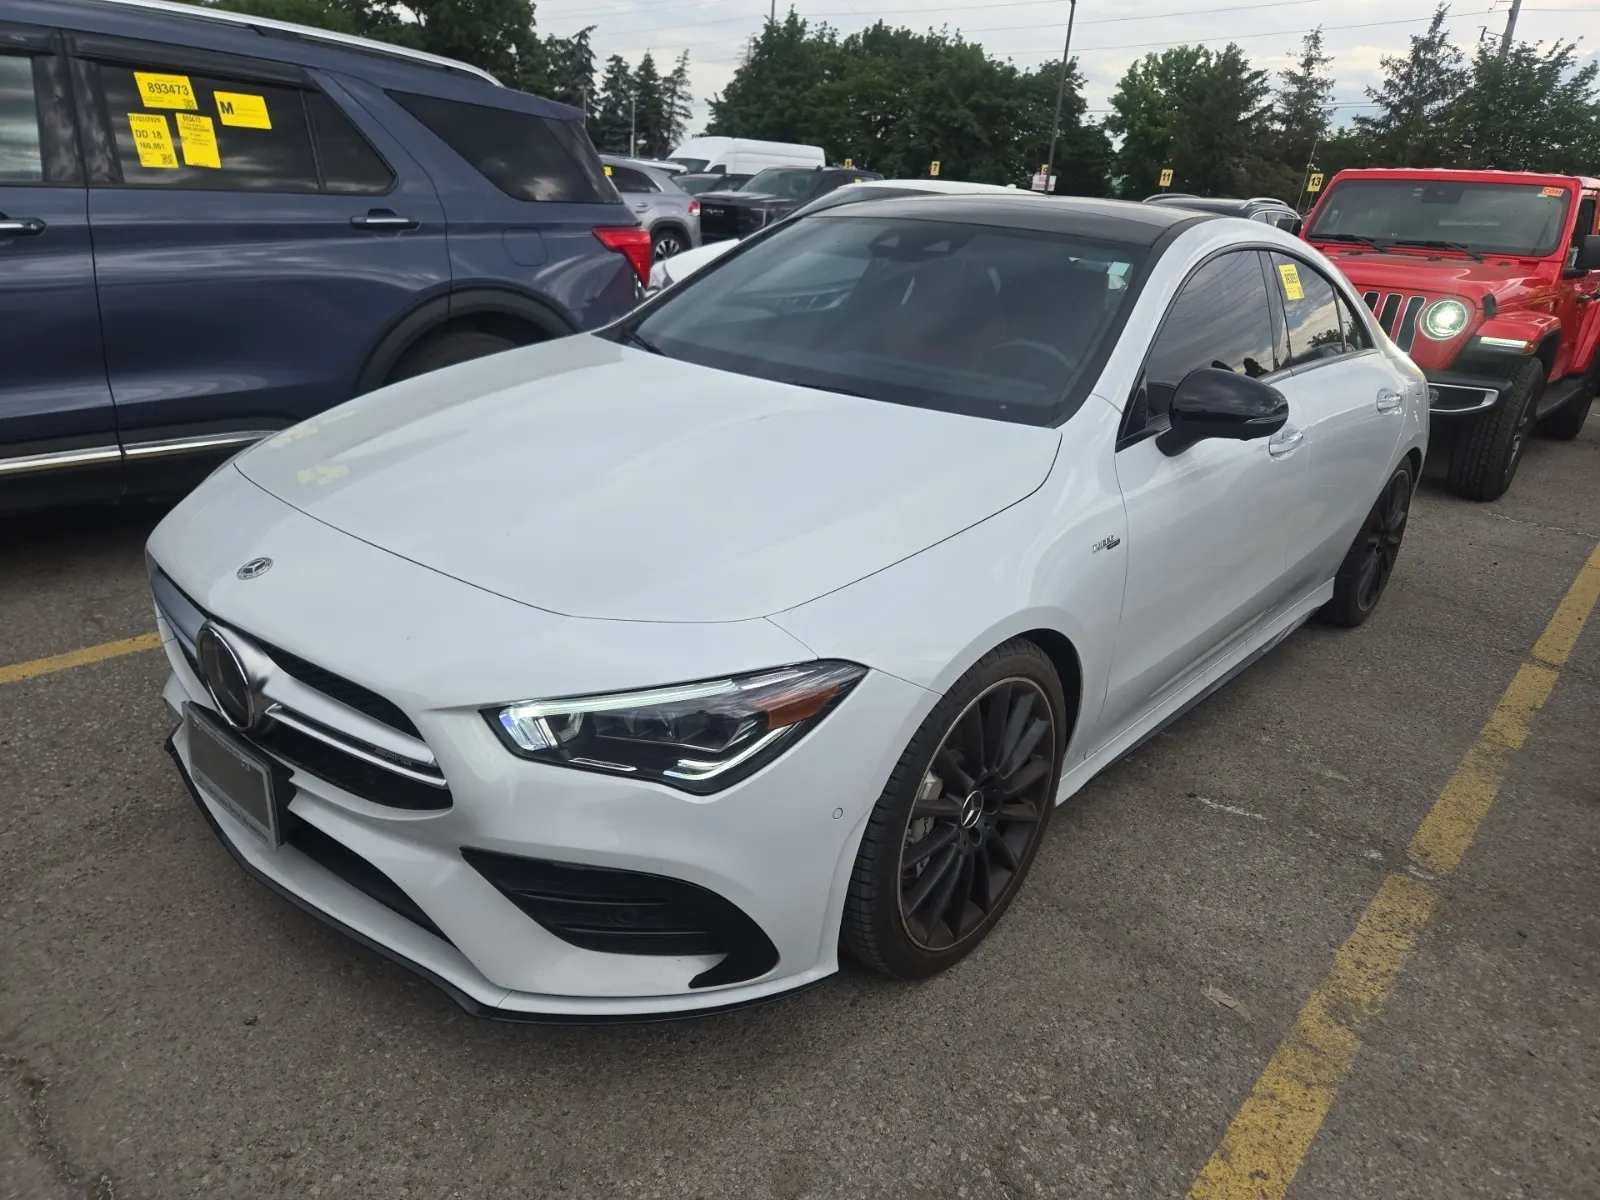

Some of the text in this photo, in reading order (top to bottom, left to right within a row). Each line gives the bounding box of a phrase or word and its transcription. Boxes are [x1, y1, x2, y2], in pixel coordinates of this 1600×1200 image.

[147, 82, 190, 96] 893473
[219, 101, 235, 115] M
[135, 129, 162, 139] DD 18
[1162, 172, 1171, 181] 11
[1311, 176, 1322, 187] 13
